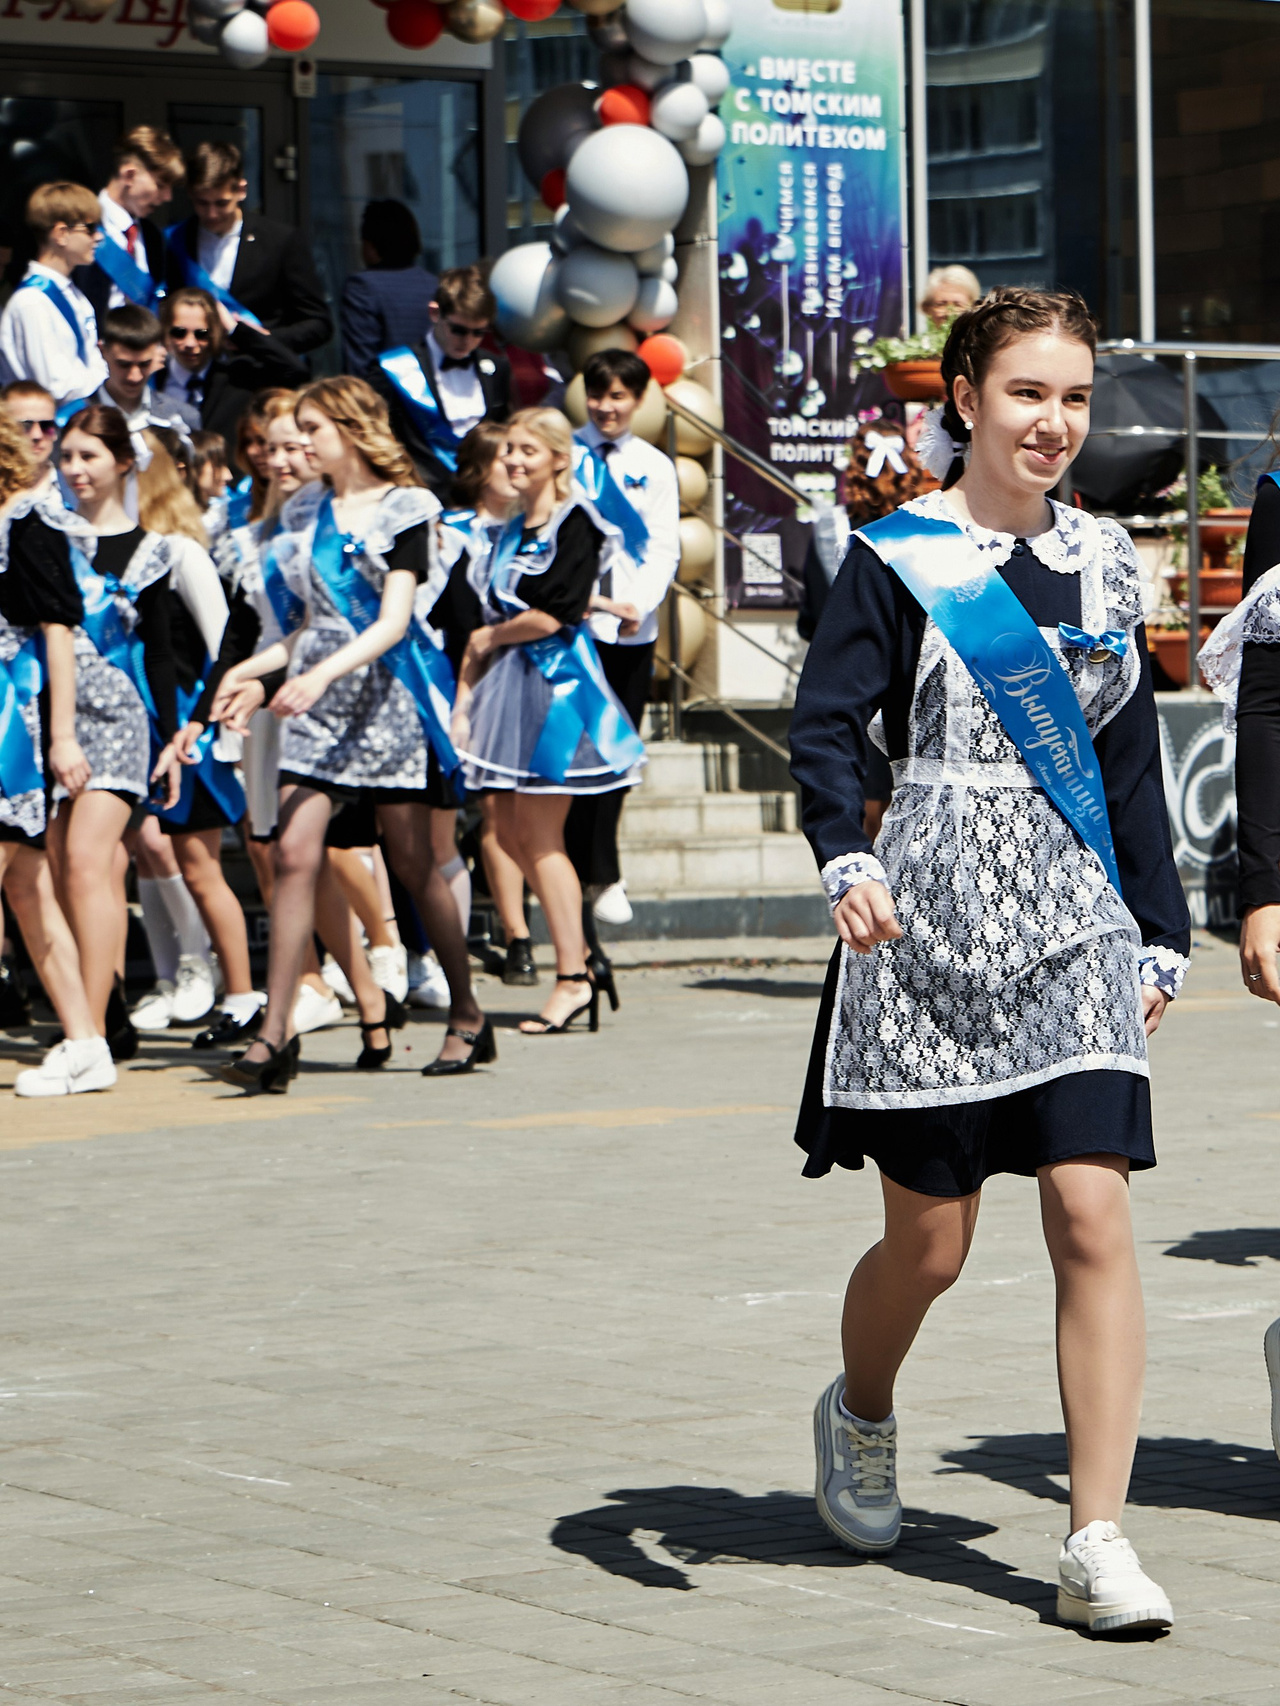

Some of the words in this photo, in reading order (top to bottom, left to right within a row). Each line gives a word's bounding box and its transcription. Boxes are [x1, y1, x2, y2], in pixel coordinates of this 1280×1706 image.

[759, 56, 856, 84] ВМЕСТЕ
[734, 88, 751, 112] С
[756, 88, 882, 118] ТОМСКИМ
[731, 120, 887, 151] ПОЛИТЕХОМ
[776, 161, 795, 249] Учимся
[826, 162, 846, 249] вперед
[801, 161, 820, 315] Развиваемся
[767, 414, 859, 438] ТОМСКИЙ
[988, 632, 1105, 826] Выпускница
